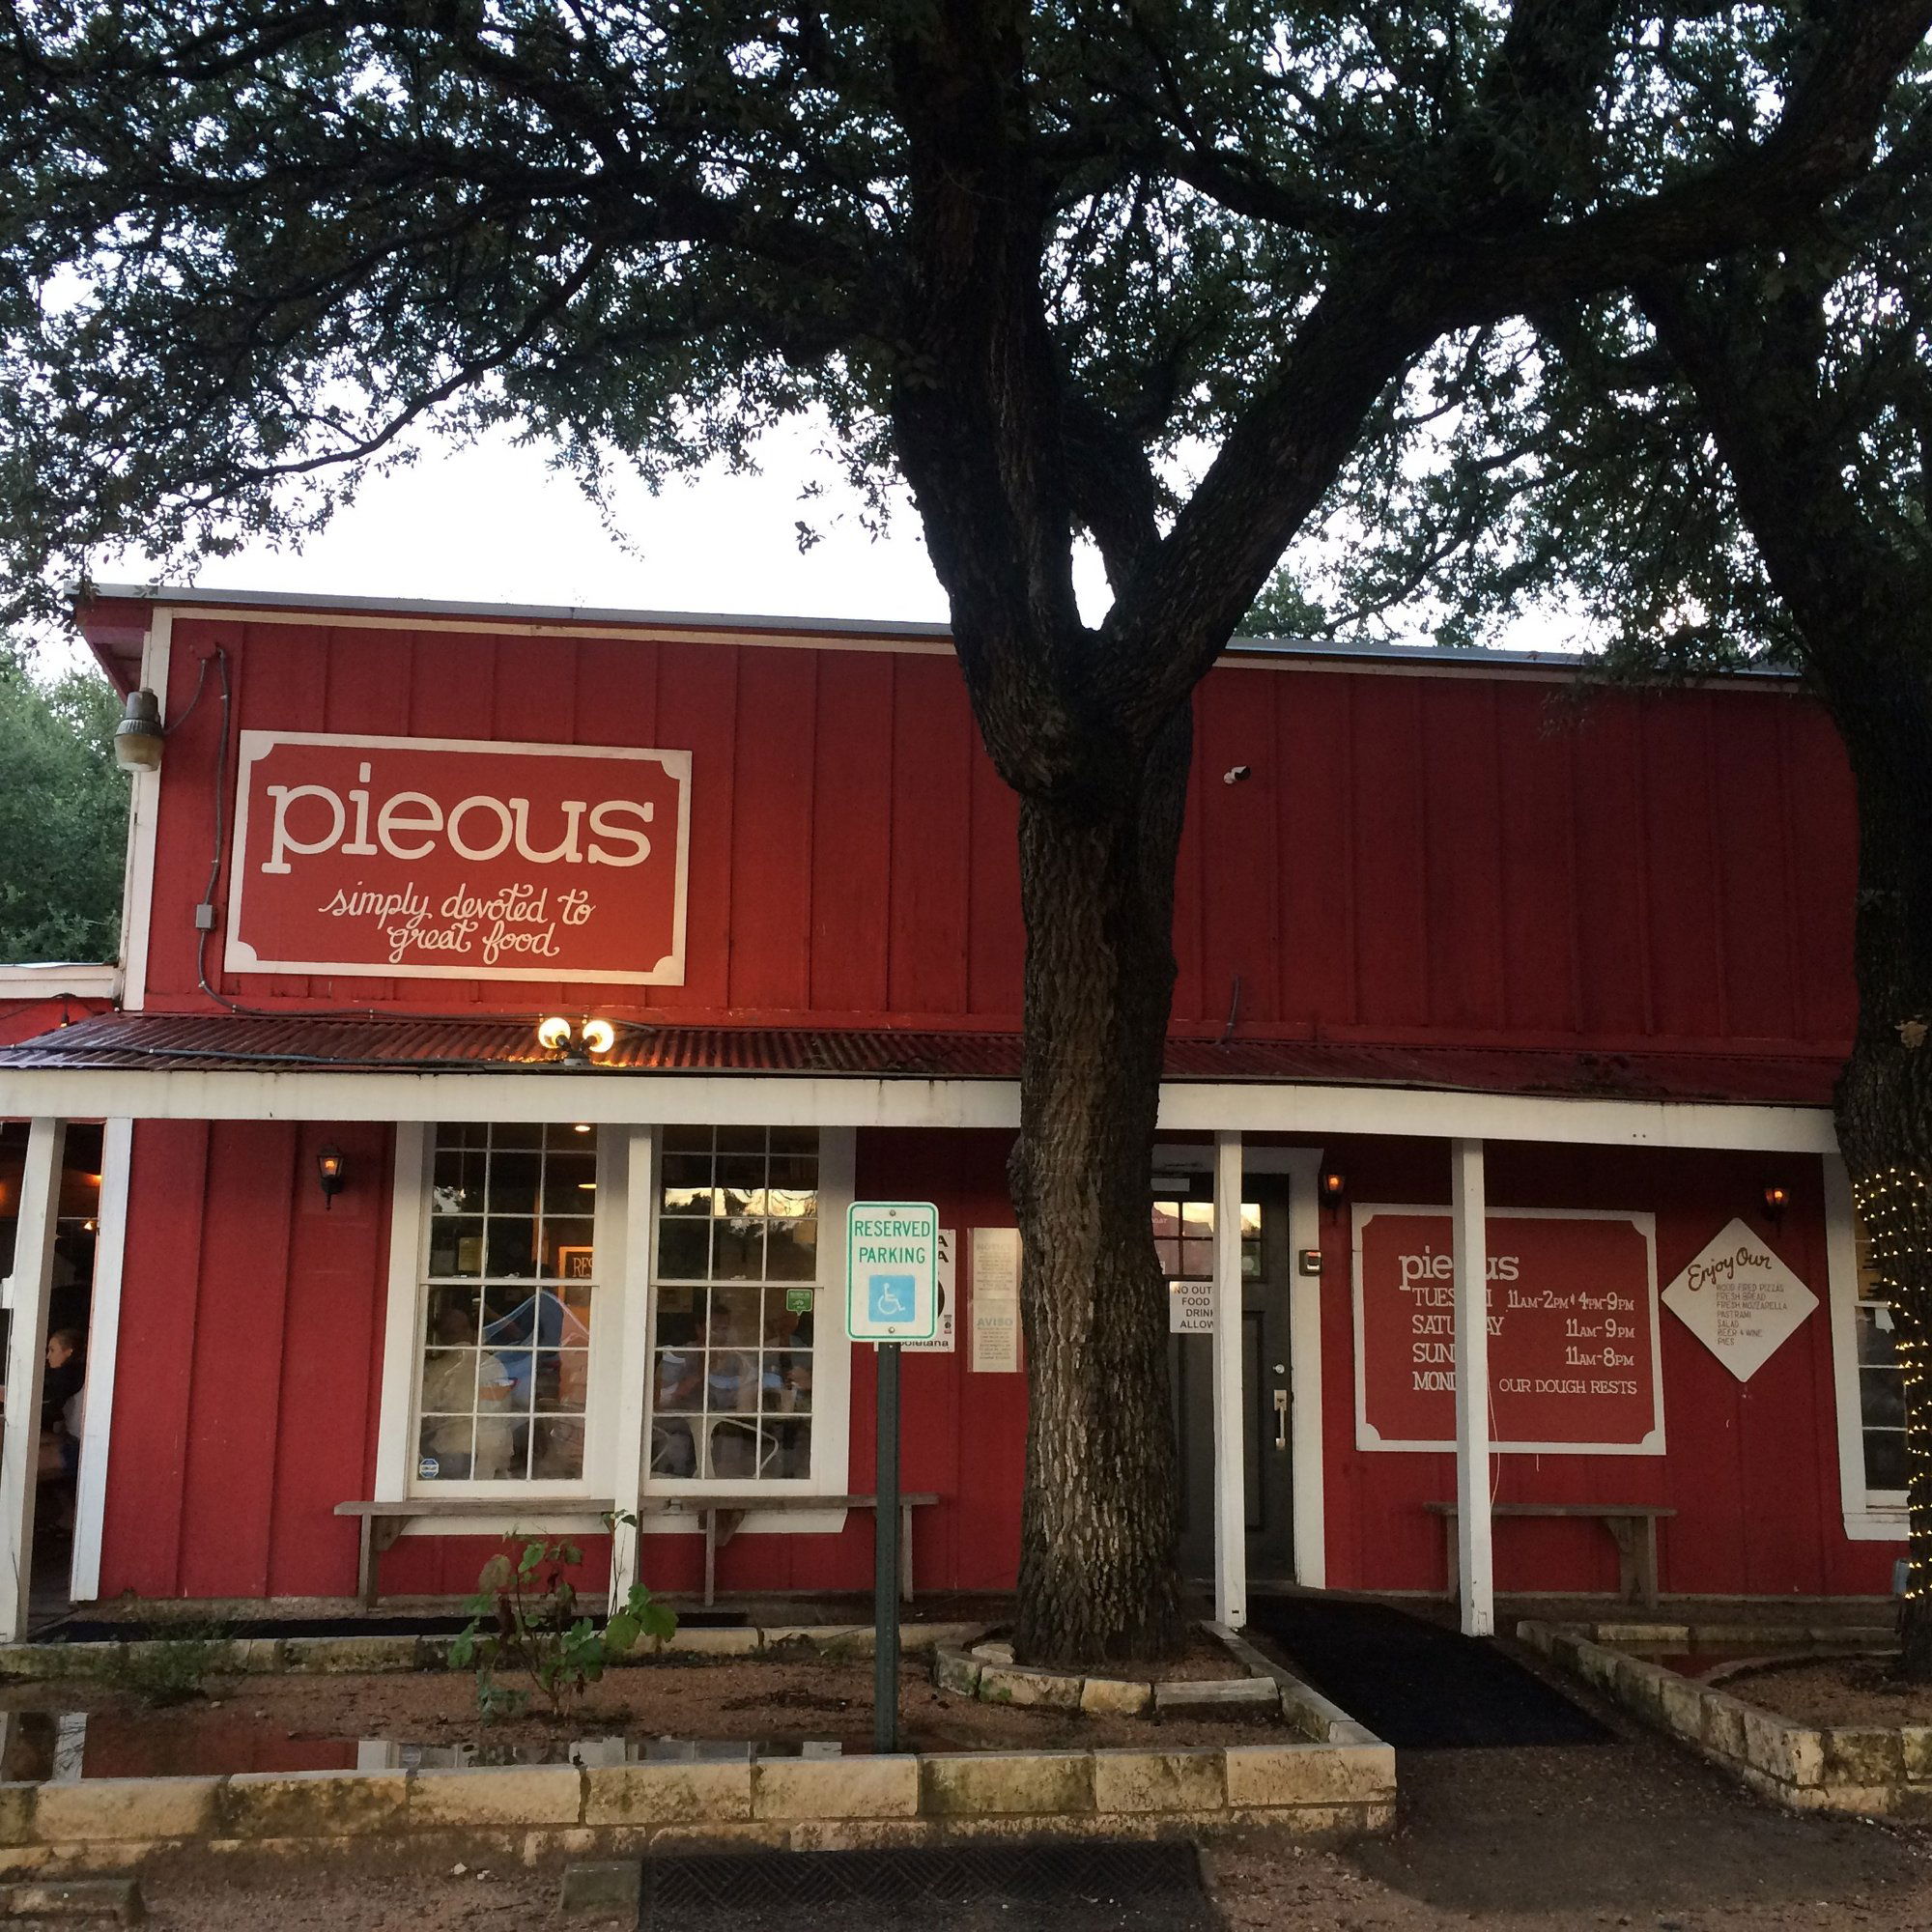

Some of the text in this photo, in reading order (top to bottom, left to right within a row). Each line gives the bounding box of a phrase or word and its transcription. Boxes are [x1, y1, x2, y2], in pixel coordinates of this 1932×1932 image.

[261, 761, 654, 874] pieous
[318, 881, 596, 929] simply devoted to
[386, 919, 560, 965] great food
[854, 1220, 930, 1237] RESERVED
[859, 1247, 925, 1264] PARKING
[1398, 1245, 1520, 1291] pieus
[1688, 1247, 1772, 1292] Enjoy Our
[1174, 1286, 1213, 1294] NO OUT
[1181, 1297, 1210, 1306] FOOD
[977, 1318, 1013, 1326] AVISO
[1411, 1315, 1505, 1336] SATUAY
[1717, 1320, 1739, 1328] SALAD
[1412, 1342, 1456, 1363] SUN
[1498, 1378, 1531, 1393] OUR
[1535, 1378, 1586, 1394] DOUGH
[1590, 1379, 1637, 1395] RESTS
